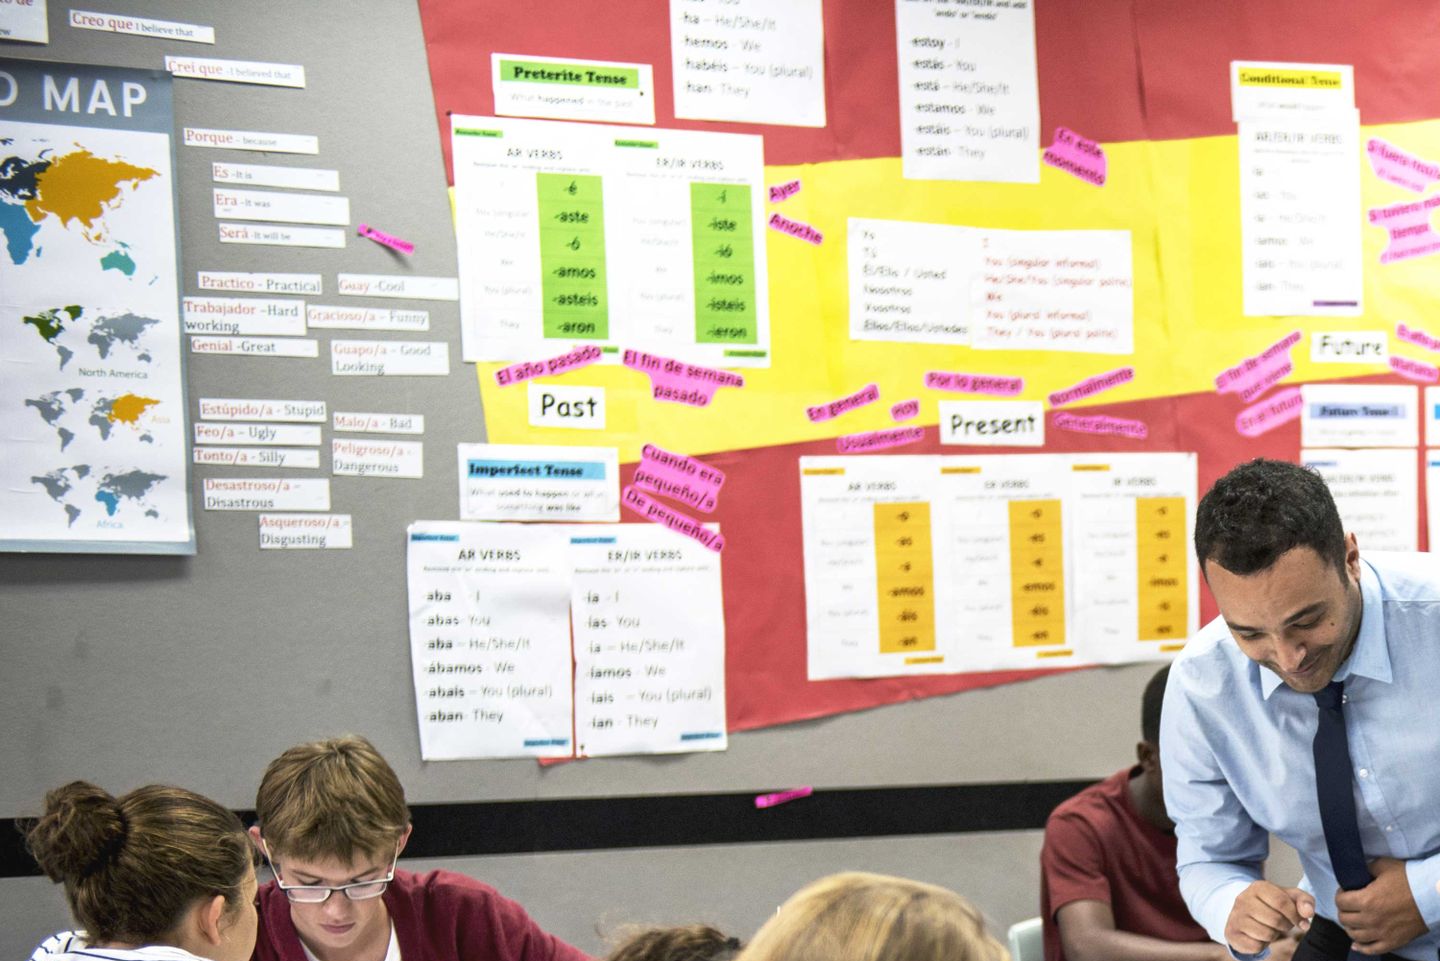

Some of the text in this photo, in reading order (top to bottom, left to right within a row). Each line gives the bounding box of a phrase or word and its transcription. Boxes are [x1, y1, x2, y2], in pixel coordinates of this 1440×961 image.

[72, 12, 104, 27] Creo
[107, 17, 133, 32] que
[141, 23, 172, 36] believe
[174, 26, 194, 37] that
[198, 62, 223, 77] que
[235, 67, 272, 79] believed
[273, 69, 292, 79] that
[513, 65, 628, 86] Preterite Tense
[43, 74, 147, 118] MAP
[186, 130, 277, 147] Porque because
[213, 166, 229, 178] Es
[769, 180, 800, 201] Ayer
[215, 193, 238, 206] Era
[253, 200, 272, 208] was
[219, 226, 249, 239] Será
[262, 231, 280, 241] will
[280, 232, 292, 241] be
[769, 213, 823, 244] Anoche
[202, 275, 321, 293] Practico Practical
[338, 279, 370, 294] Guay
[184, 301, 257, 319] Trabajador
[306, 308, 429, 327] Gracioso/a Funny
[184, 319, 240, 335] working
[191, 339, 234, 353] Genial
[333, 343, 432, 359] Guapo/a Good
[1318, 336, 1384, 356] Future
[335, 360, 386, 375] Looking
[498, 346, 602, 384] El año pasado
[623, 350, 743, 387] El fin de semana
[78, 368, 149, 380] North America
[653, 384, 708, 405] pasado
[201, 403, 325, 419] Estúpido/a Stupid
[541, 393, 598, 418] Past
[334, 415, 413, 430] Malo/a Bad
[950, 413, 1036, 437] Present
[196, 425, 278, 441] Feo/a Ugly
[193, 449, 287, 466] Tonto/a Silly
[332, 442, 405, 460] Peligroso/a
[333, 459, 400, 475] Dangerous
[469, 462, 584, 479] Imperfect Tense
[642, 444, 723, 486] Cuando era
[204, 479, 292, 495] Desastroso/a
[635, 470, 715, 509] pequeño/a
[206, 495, 275, 509] Disastrous
[259, 515, 341, 532] Asqueroso/a
[626, 488, 724, 551] De pequeño/a
[260, 531, 328, 547] Disgusting
[493, 661, 515, 674] We
[472, 709, 504, 724] They
[626, 714, 659, 730] They
